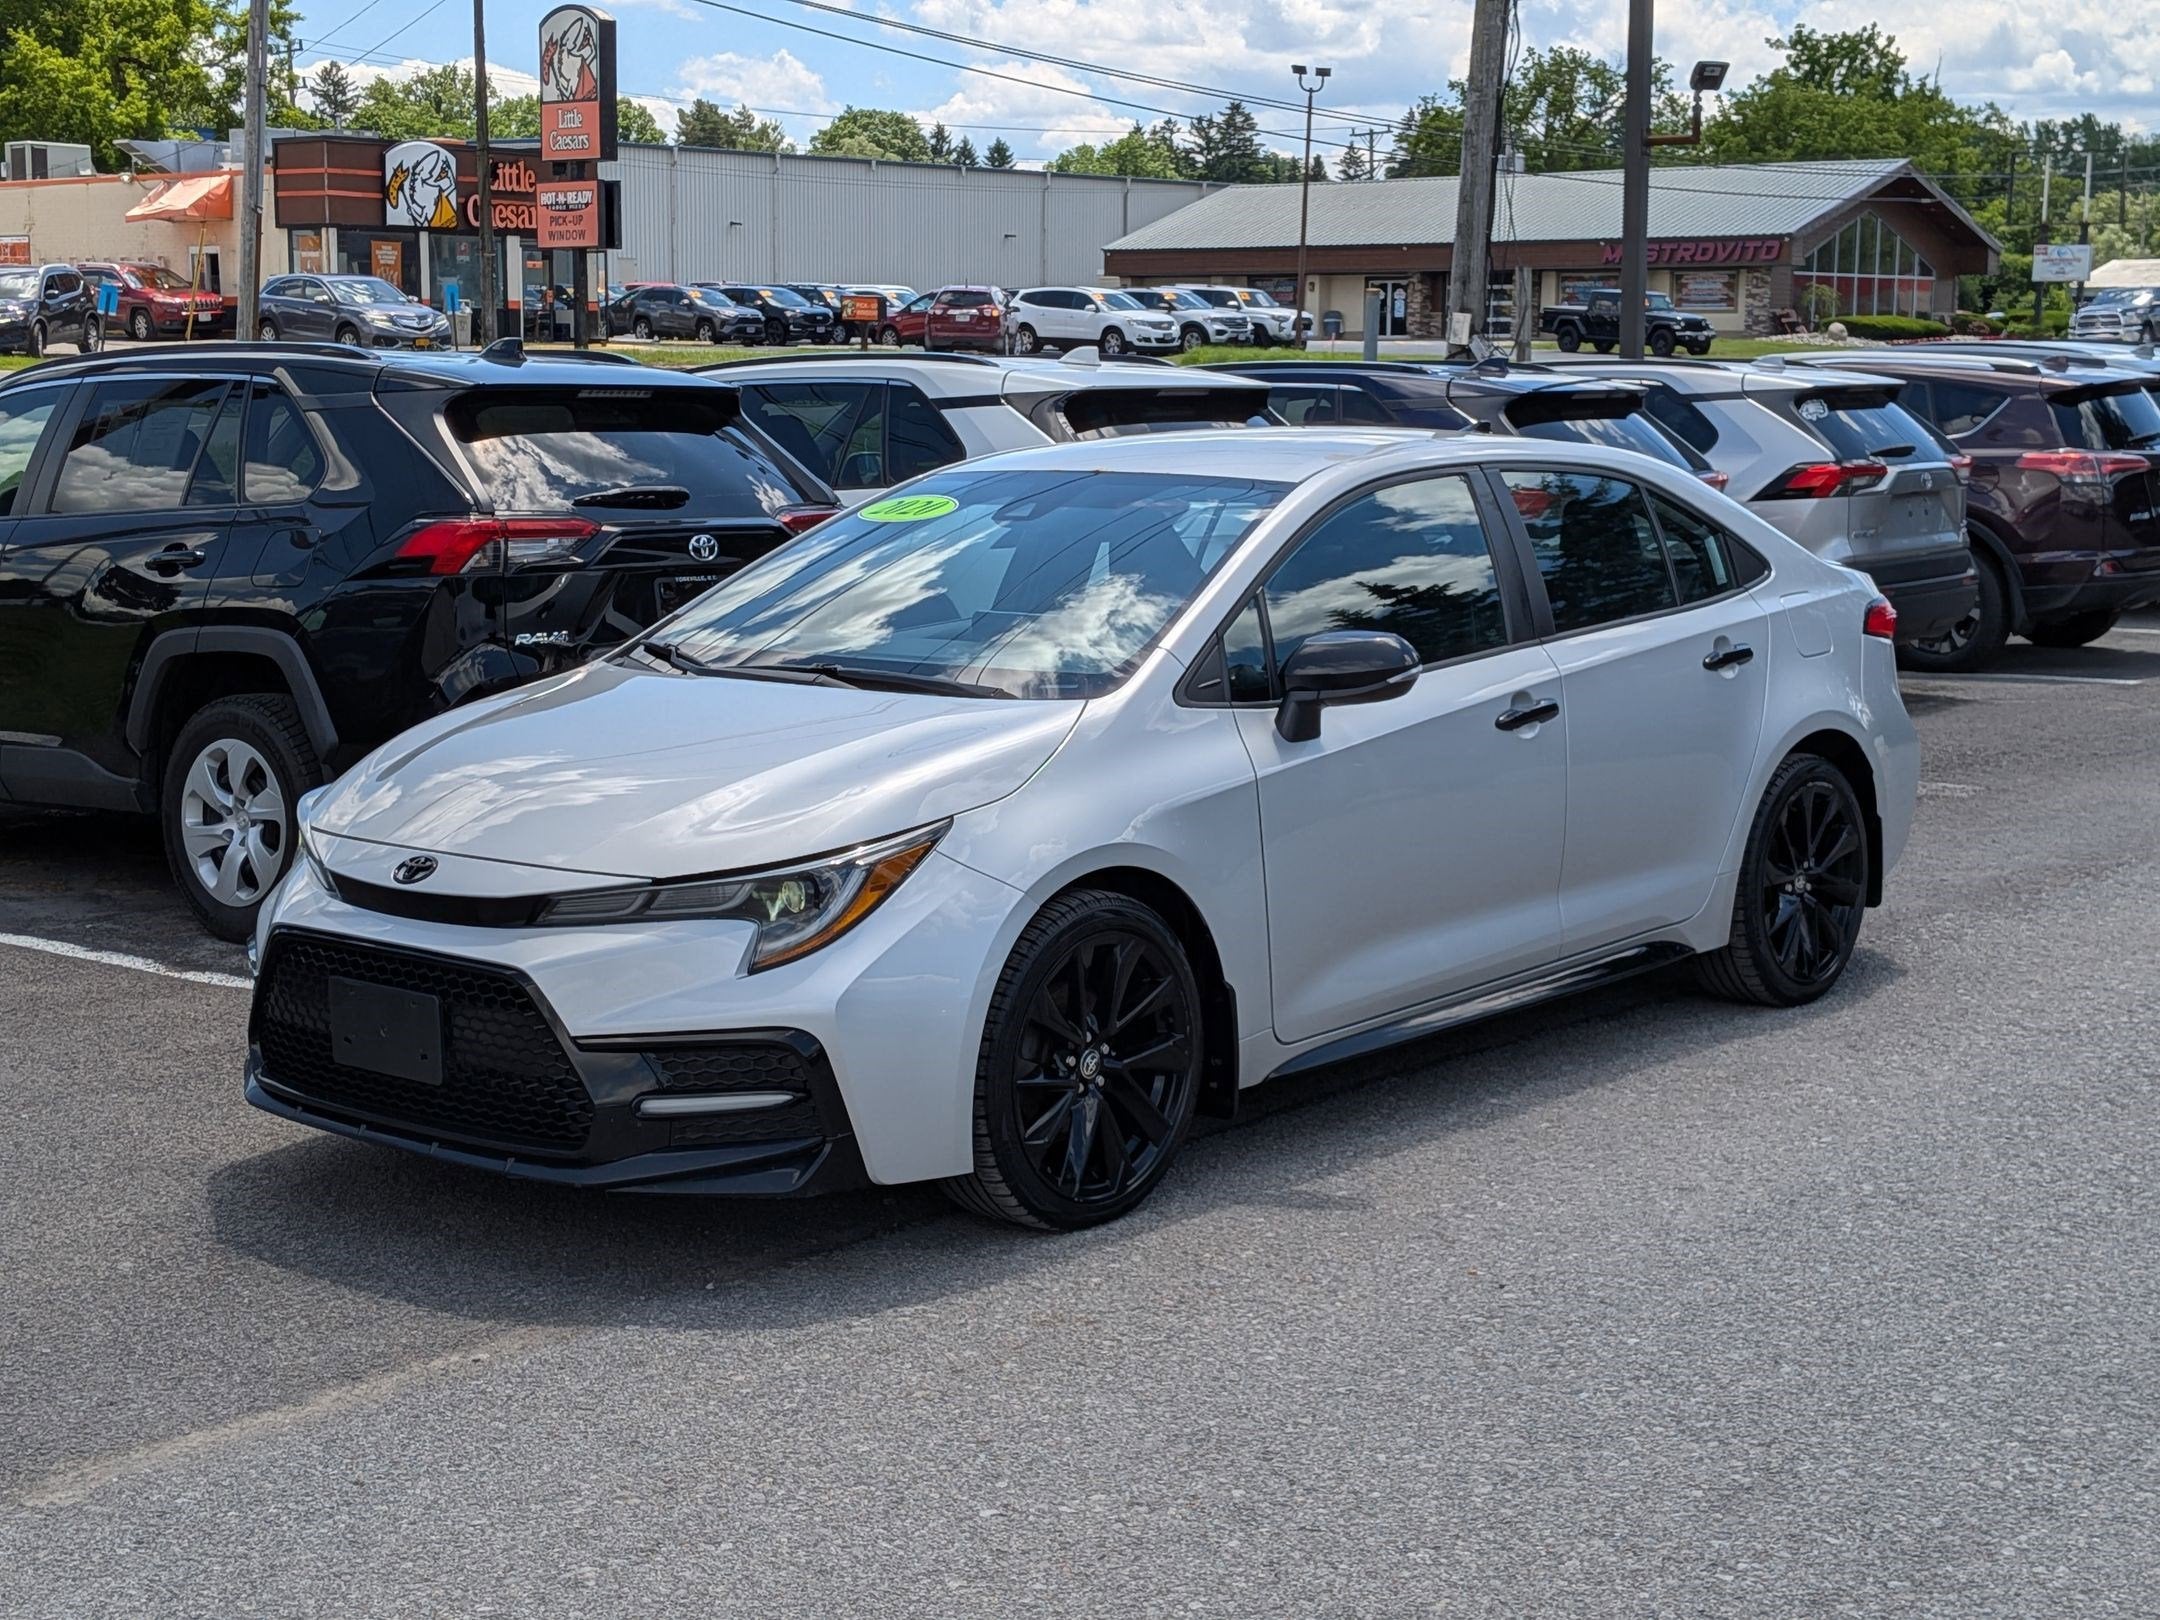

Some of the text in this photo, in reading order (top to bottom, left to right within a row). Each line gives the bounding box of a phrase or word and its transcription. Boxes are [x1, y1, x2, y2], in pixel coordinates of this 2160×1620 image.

[558, 109, 582, 129] Little
[550, 131, 589, 150] Caesars
[466, 193, 537, 229] Cesar
[549, 214, 584, 227] PICK-UP
[548, 229, 586, 241] WINDOW
[1602, 239, 1782, 264] MSTROVITO
[867, 499, 950, 516] 2020
[514, 630, 569, 646] RAV4
